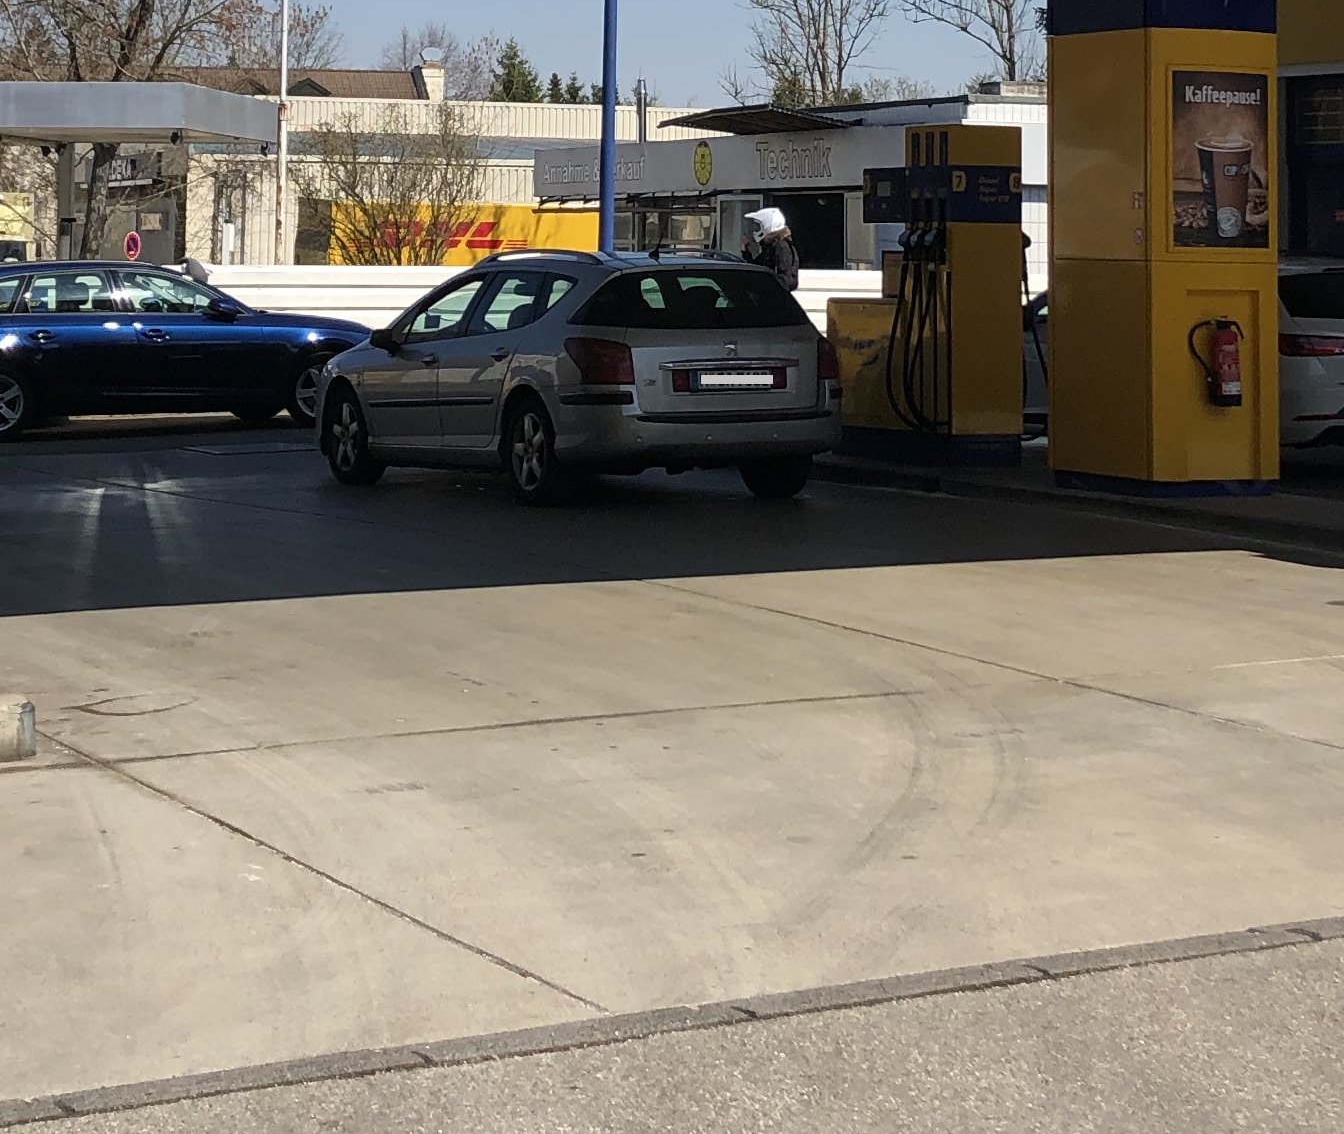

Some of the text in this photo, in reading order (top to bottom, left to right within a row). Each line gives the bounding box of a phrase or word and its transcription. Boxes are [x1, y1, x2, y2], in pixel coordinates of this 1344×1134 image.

[1185, 85, 1261, 109] Kaffeepause!
[543, 159, 590, 184] Annahme
[756, 138, 833, 181] Technik
